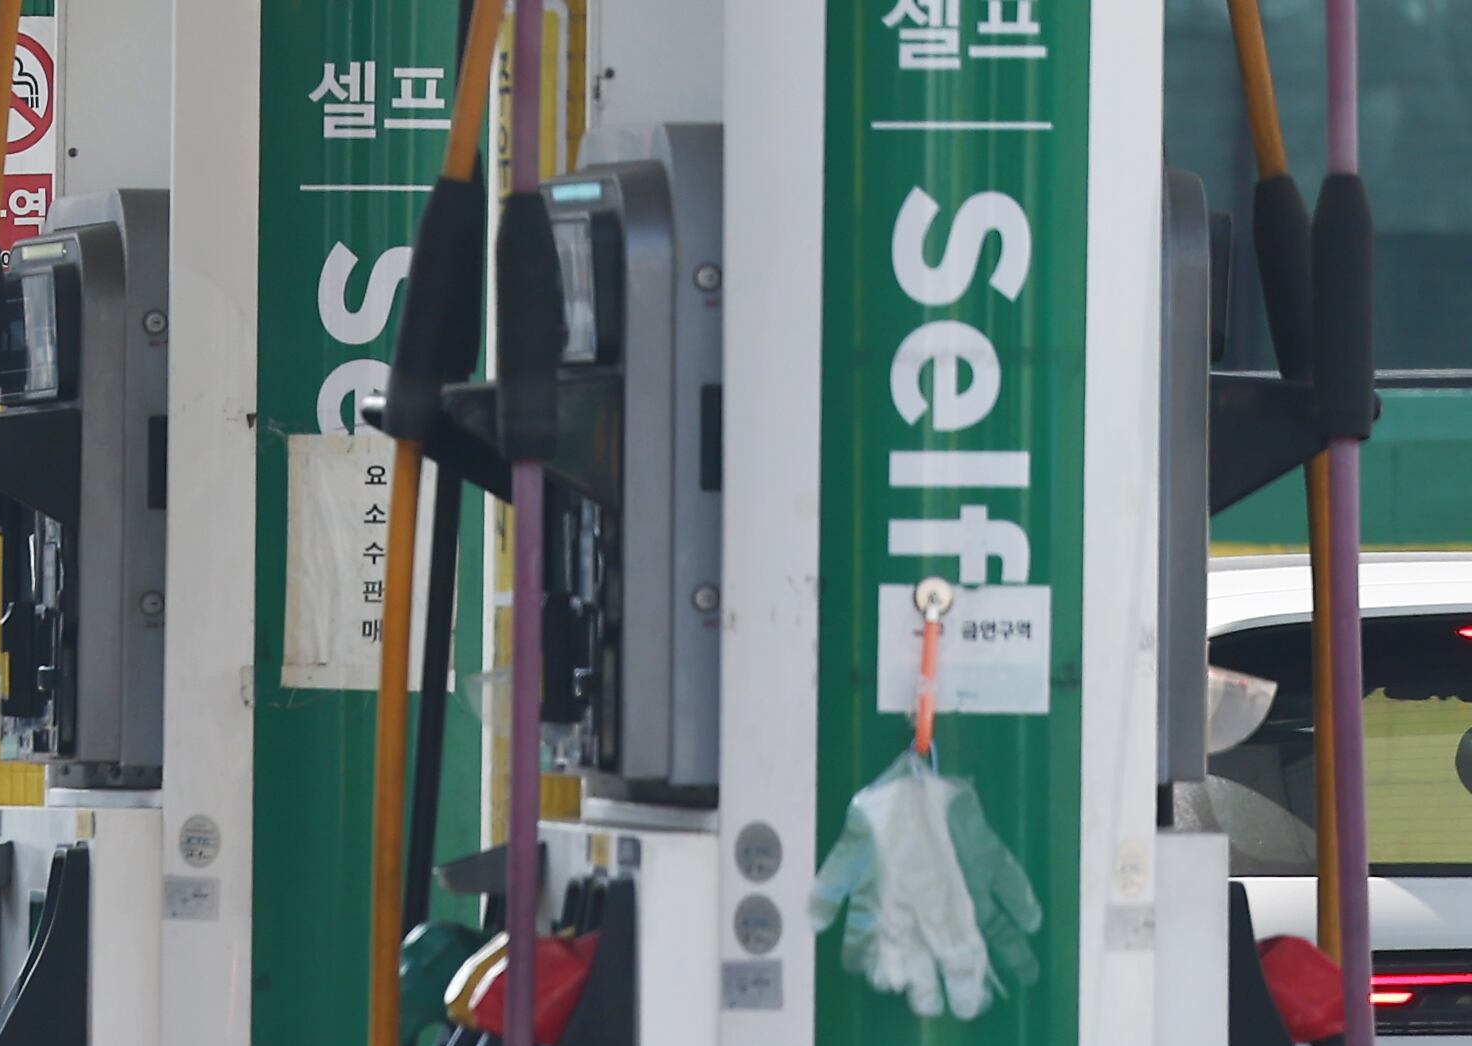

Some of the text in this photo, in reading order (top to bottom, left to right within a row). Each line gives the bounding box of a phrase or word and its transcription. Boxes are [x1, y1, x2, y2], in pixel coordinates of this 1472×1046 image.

[308, 61, 451, 138] 셀프
[889, 185, 1031, 584] Self
[961, 619, 1032, 641] 금연구역
